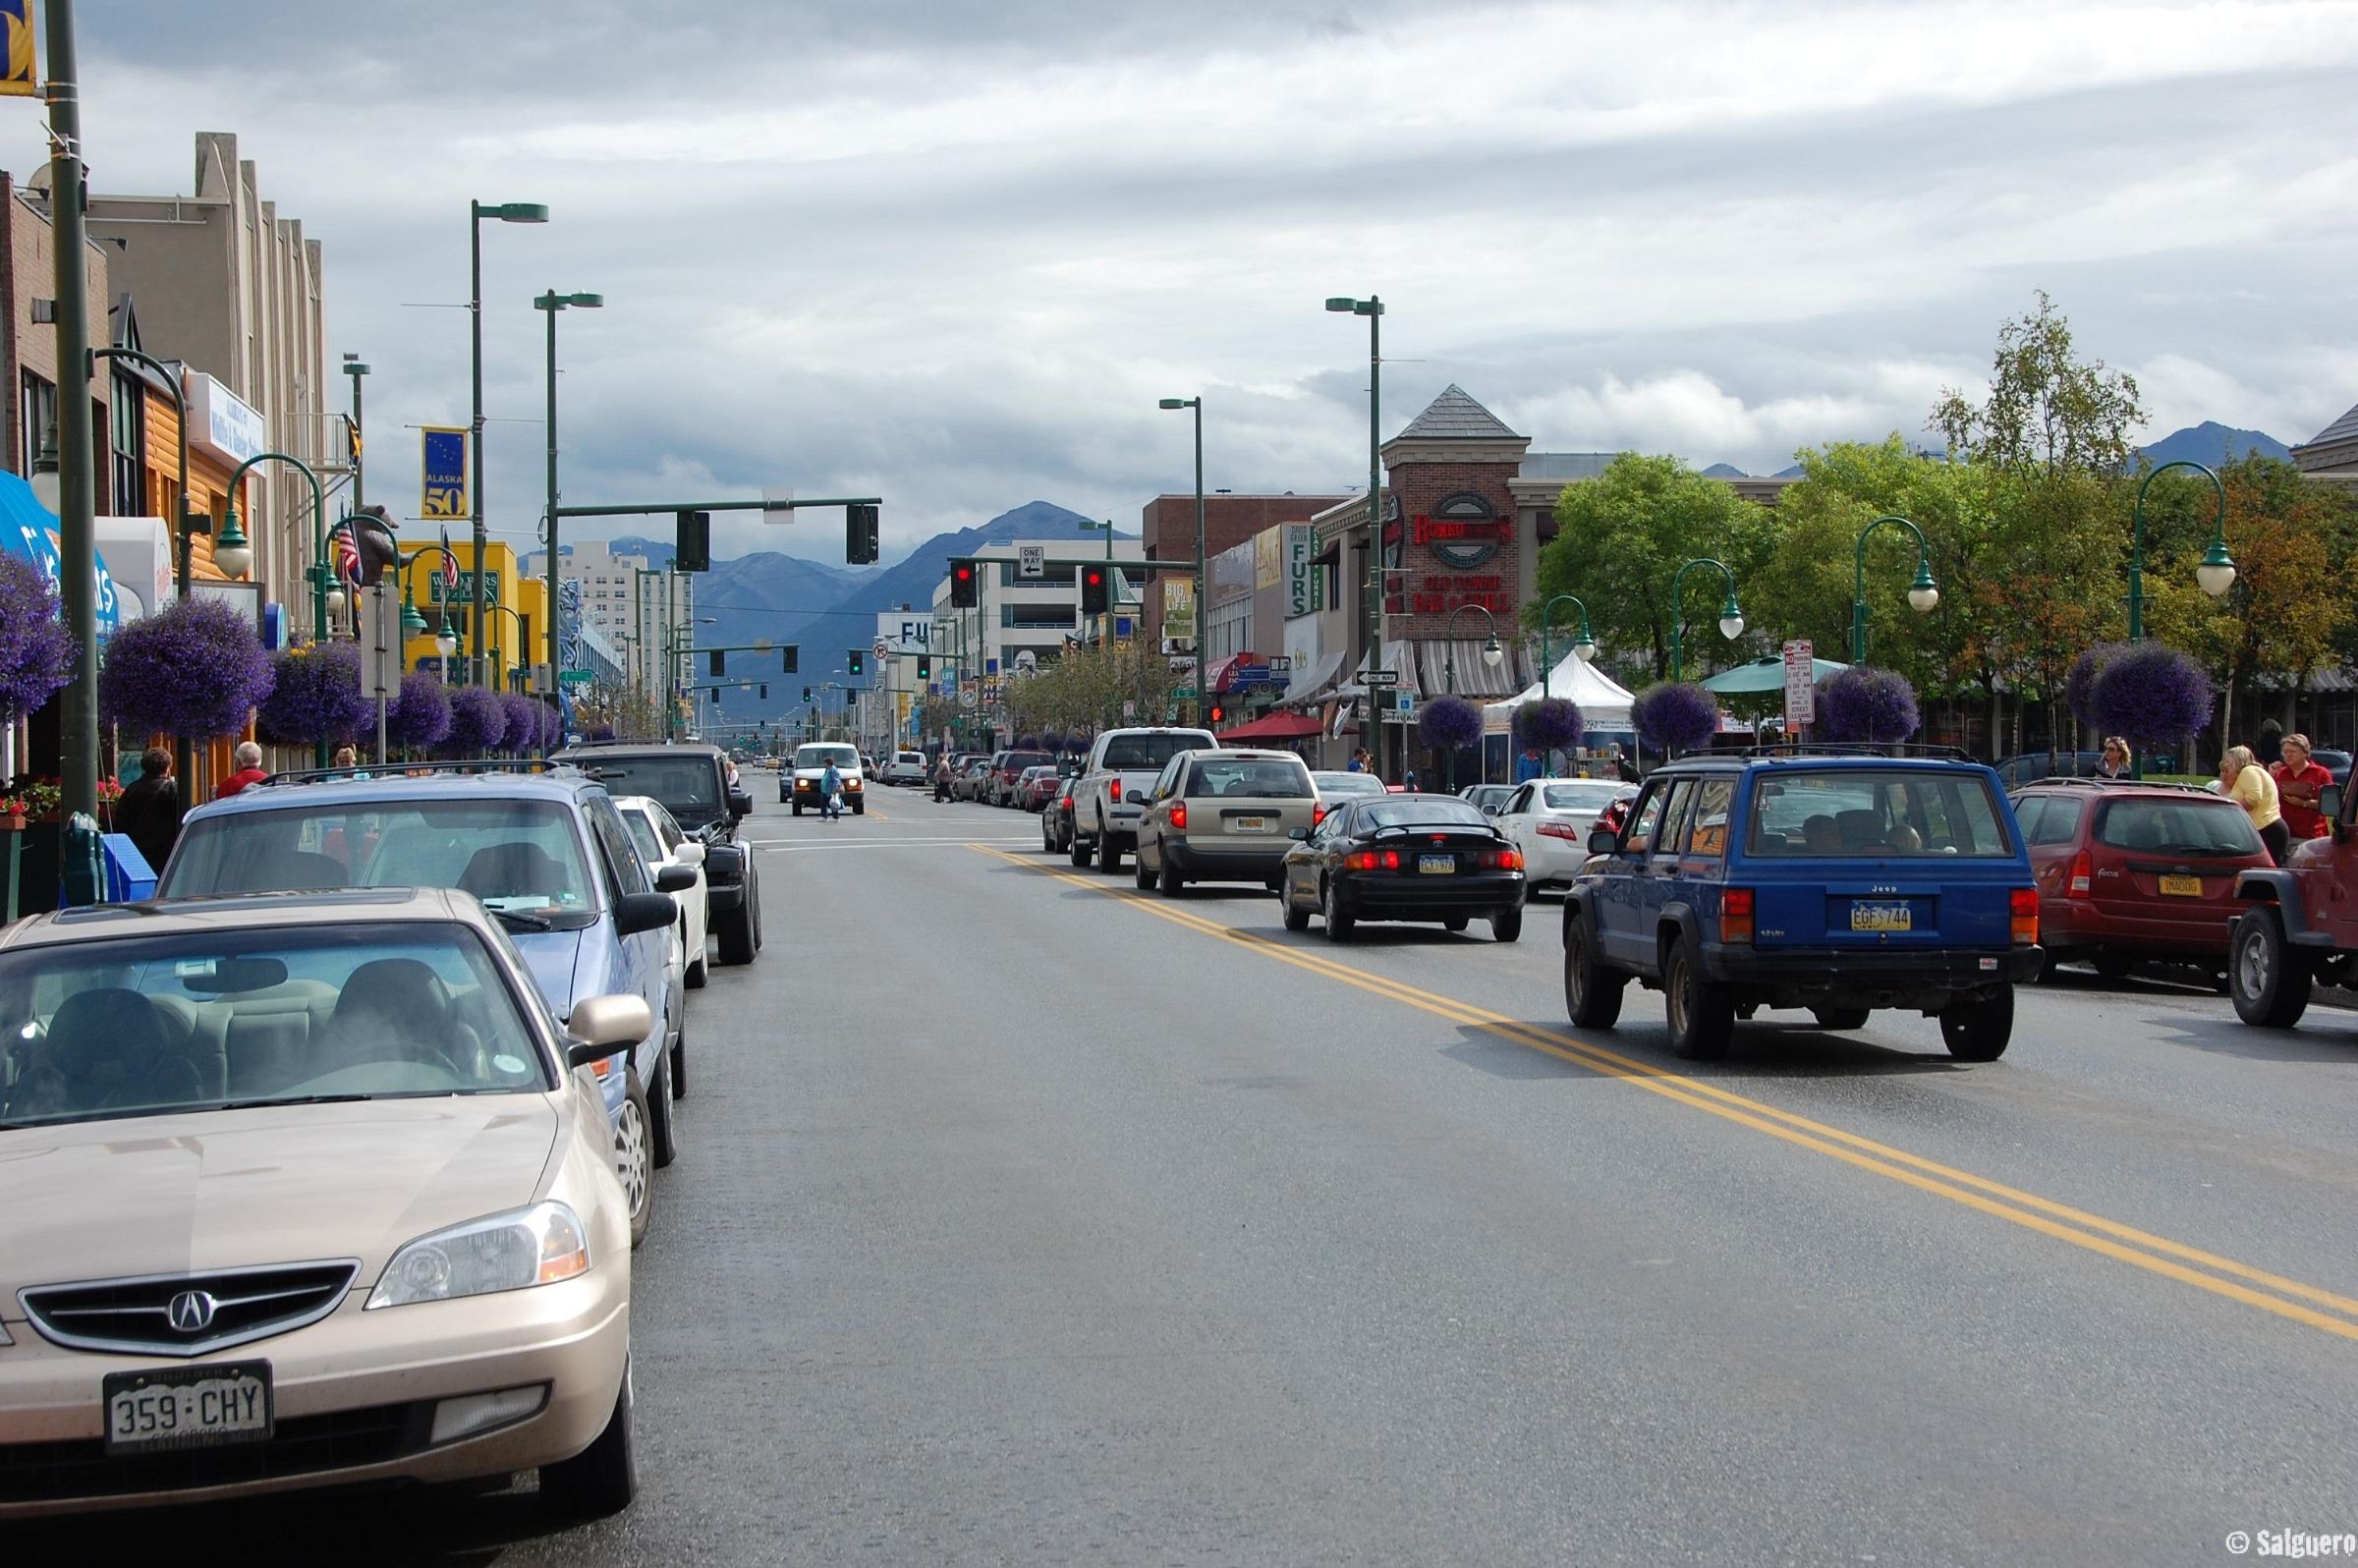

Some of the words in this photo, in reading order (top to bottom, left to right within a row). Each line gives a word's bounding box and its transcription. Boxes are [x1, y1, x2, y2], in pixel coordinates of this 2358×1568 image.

[427, 474, 463, 483] ALASKA
[425, 488, 465, 515] 50
[1292, 544, 1307, 614] FURS
[1165, 584, 1184, 596] BIG
[1167, 601, 1186, 611] LIFE
[901, 622, 933, 644] FU
